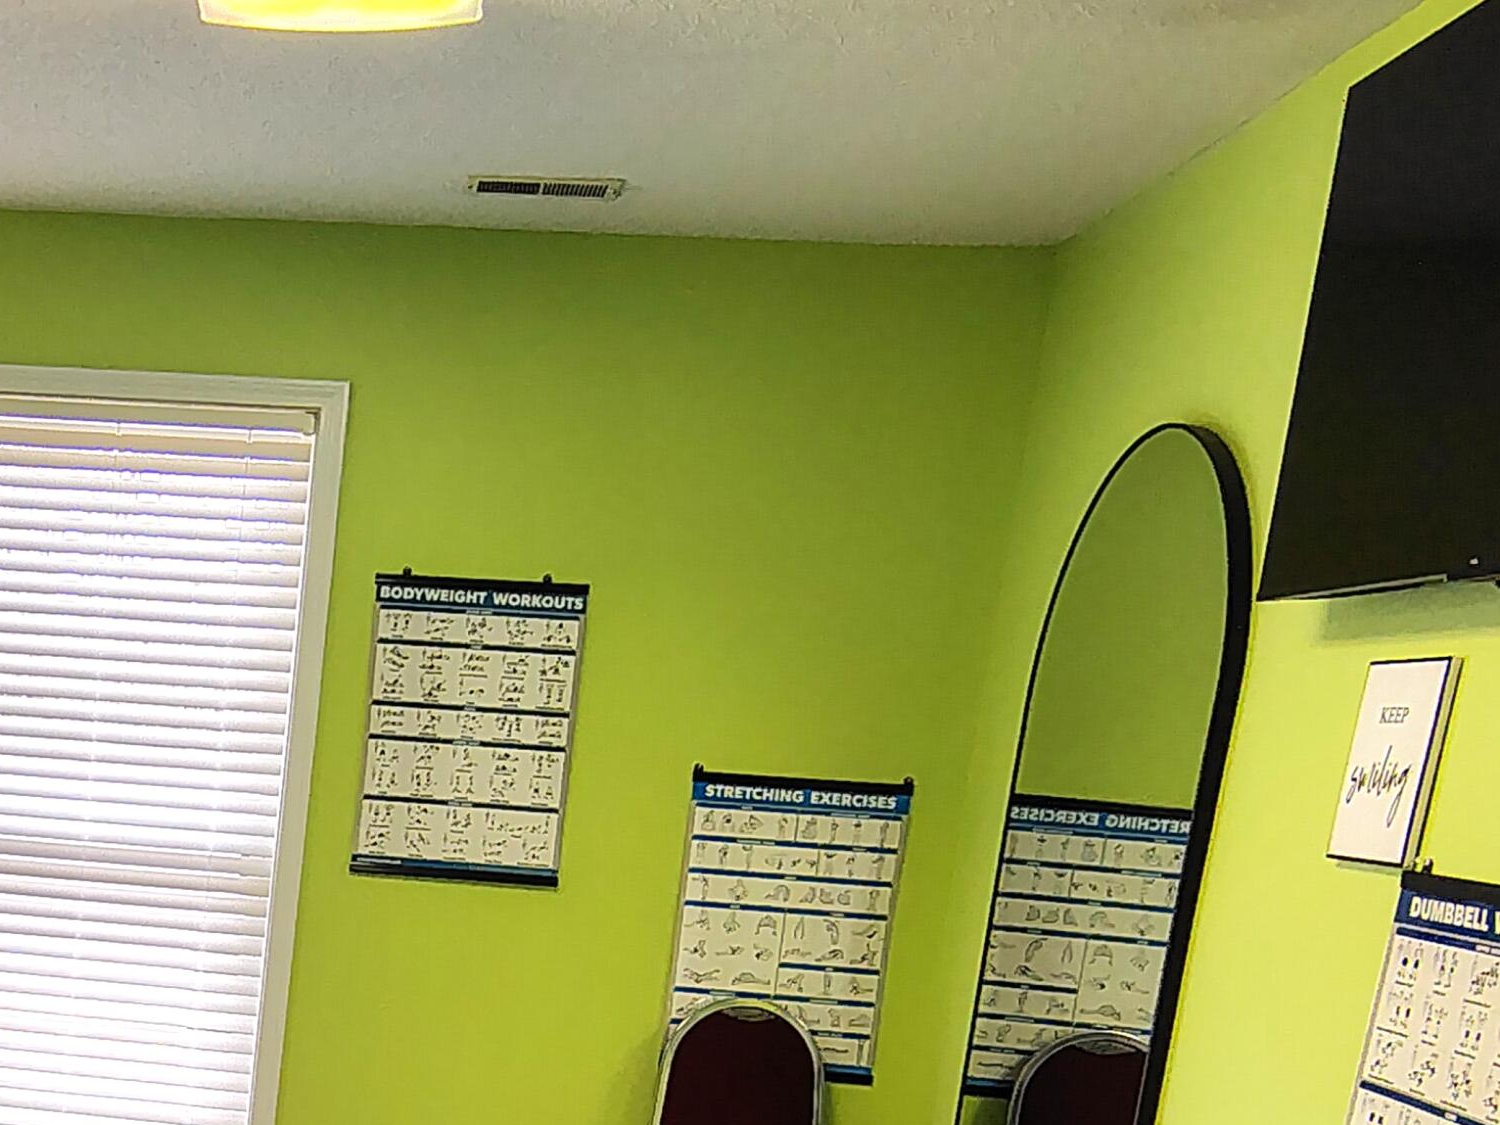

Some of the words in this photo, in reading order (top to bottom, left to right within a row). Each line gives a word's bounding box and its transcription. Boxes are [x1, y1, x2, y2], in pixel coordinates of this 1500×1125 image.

[379, 585, 488, 605] BODYWEIGHT
[492, 593, 584, 610] WORKOUTS
[1379, 706, 1409, 724] KEEP
[704, 784, 804, 803] STRETCHING
[810, 791, 898, 809] EXERCISES
[1346, 744, 1412, 828] smiling
[1409, 896, 1489, 932] DUMBBELL
